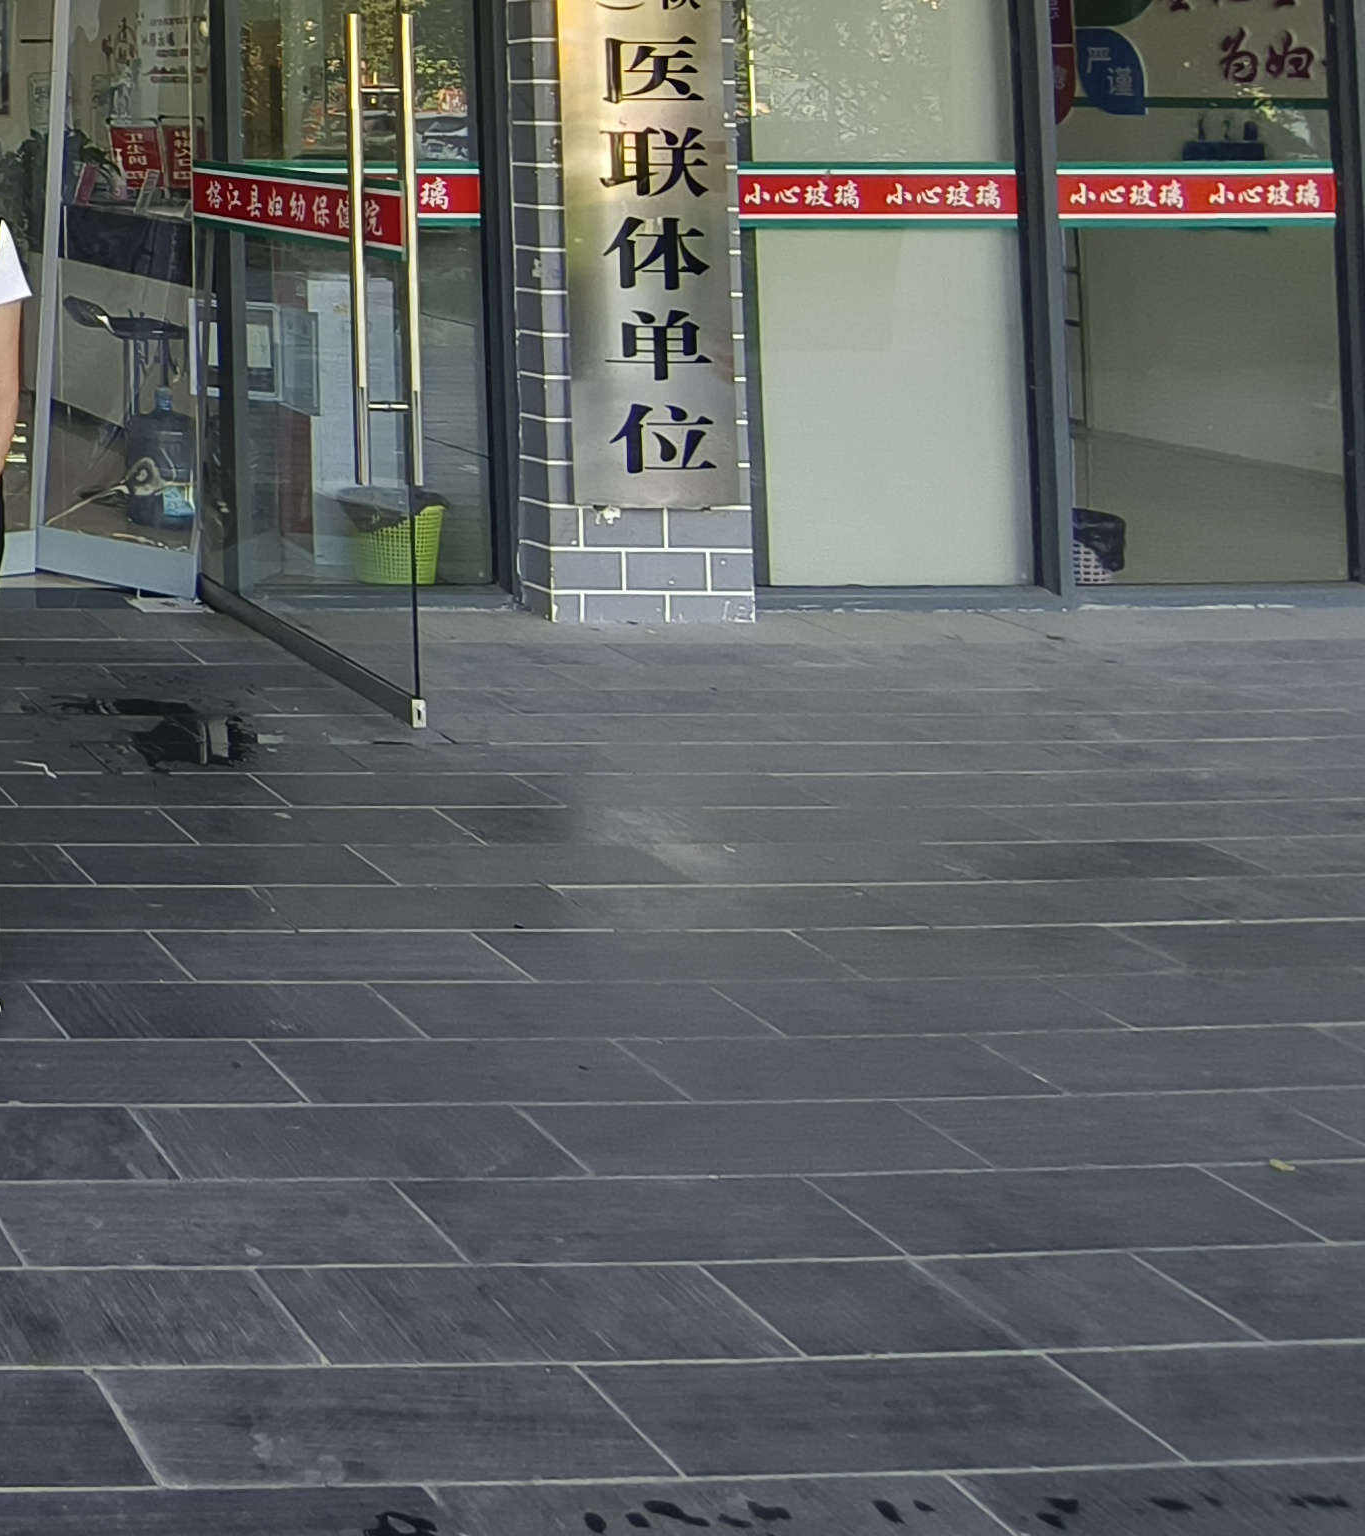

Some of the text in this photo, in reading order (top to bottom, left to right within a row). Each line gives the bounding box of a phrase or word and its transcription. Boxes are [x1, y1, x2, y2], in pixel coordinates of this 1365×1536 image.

[1085, 46, 1136, 97] 严谨
[1218, 27, 1327, 83] 为妇
[744, 181, 1003, 210] 小心玻璃 小心玻璃
[1069, 181, 1322, 211] 小心玻璃 小心玻璃
[599, 35, 718, 476] 医联体单位
